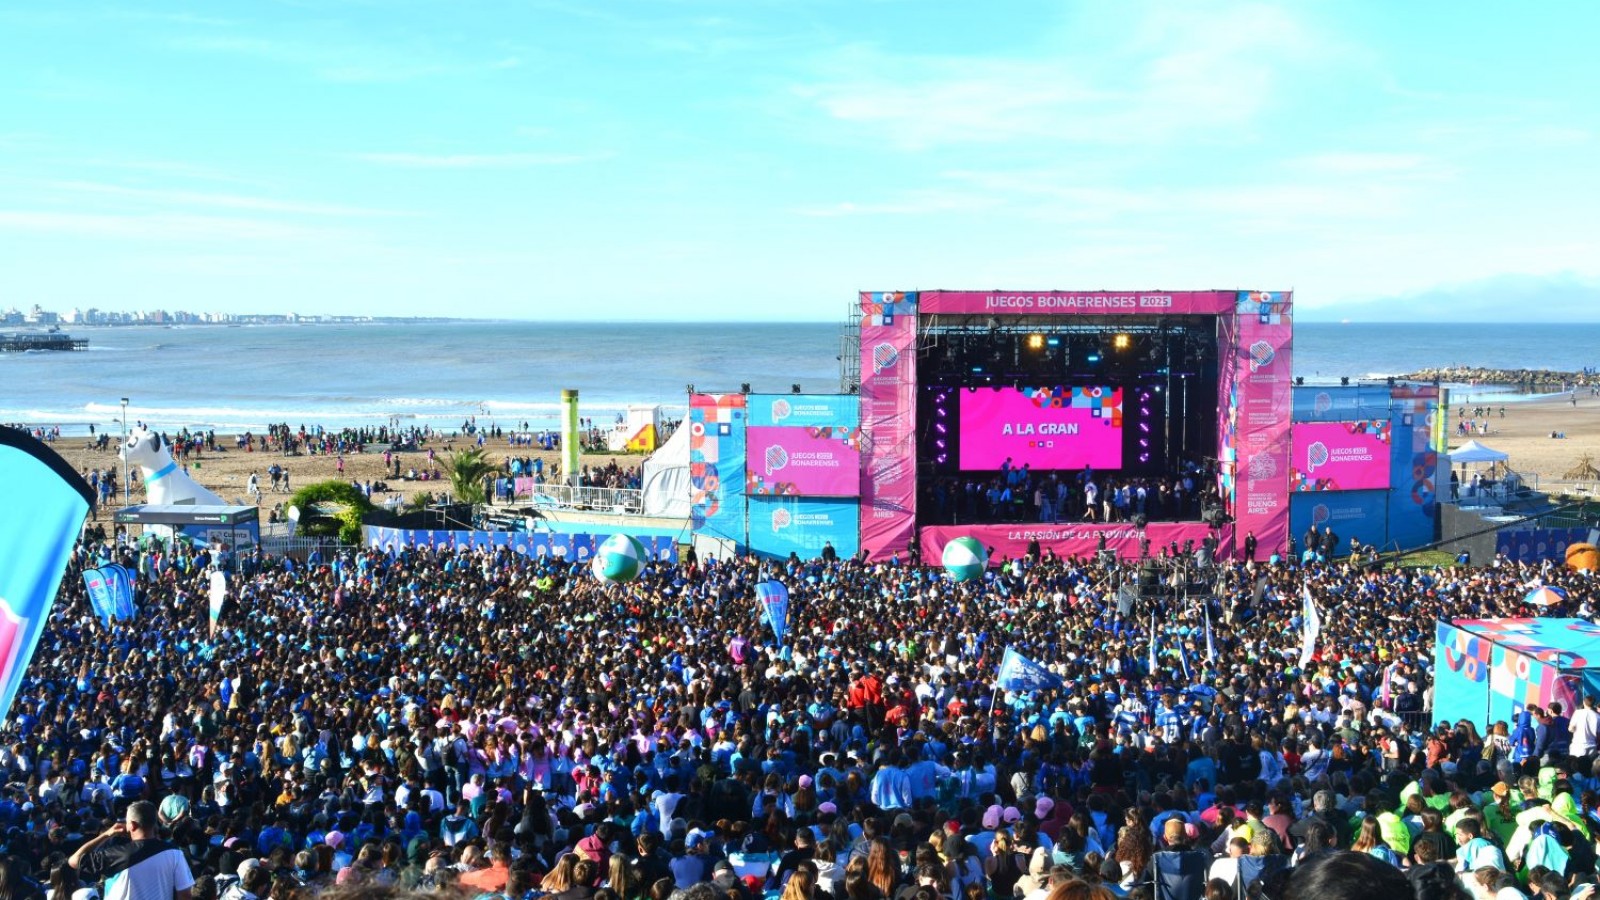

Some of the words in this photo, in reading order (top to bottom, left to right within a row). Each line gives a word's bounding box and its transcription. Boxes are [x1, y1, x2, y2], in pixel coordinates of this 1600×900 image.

[986, 296, 1034, 309] JUEGOS
[1038, 296, 1136, 307] BONAERENSES
[1143, 297, 1169, 306] 2025
[1002, 423, 1013, 435] A
[1016, 423, 1035, 435] LA
[1038, 423, 1078, 435] GRAN
[791, 452, 815, 460] JUEGOS
[1330, 454, 1373, 462] BONAERENSES
[1247, 500, 1278, 508] BUENOS
[1008, 531, 1021, 540] LA
[1062, 530, 1075, 539] DE
[1077, 530, 1090, 539] LA
